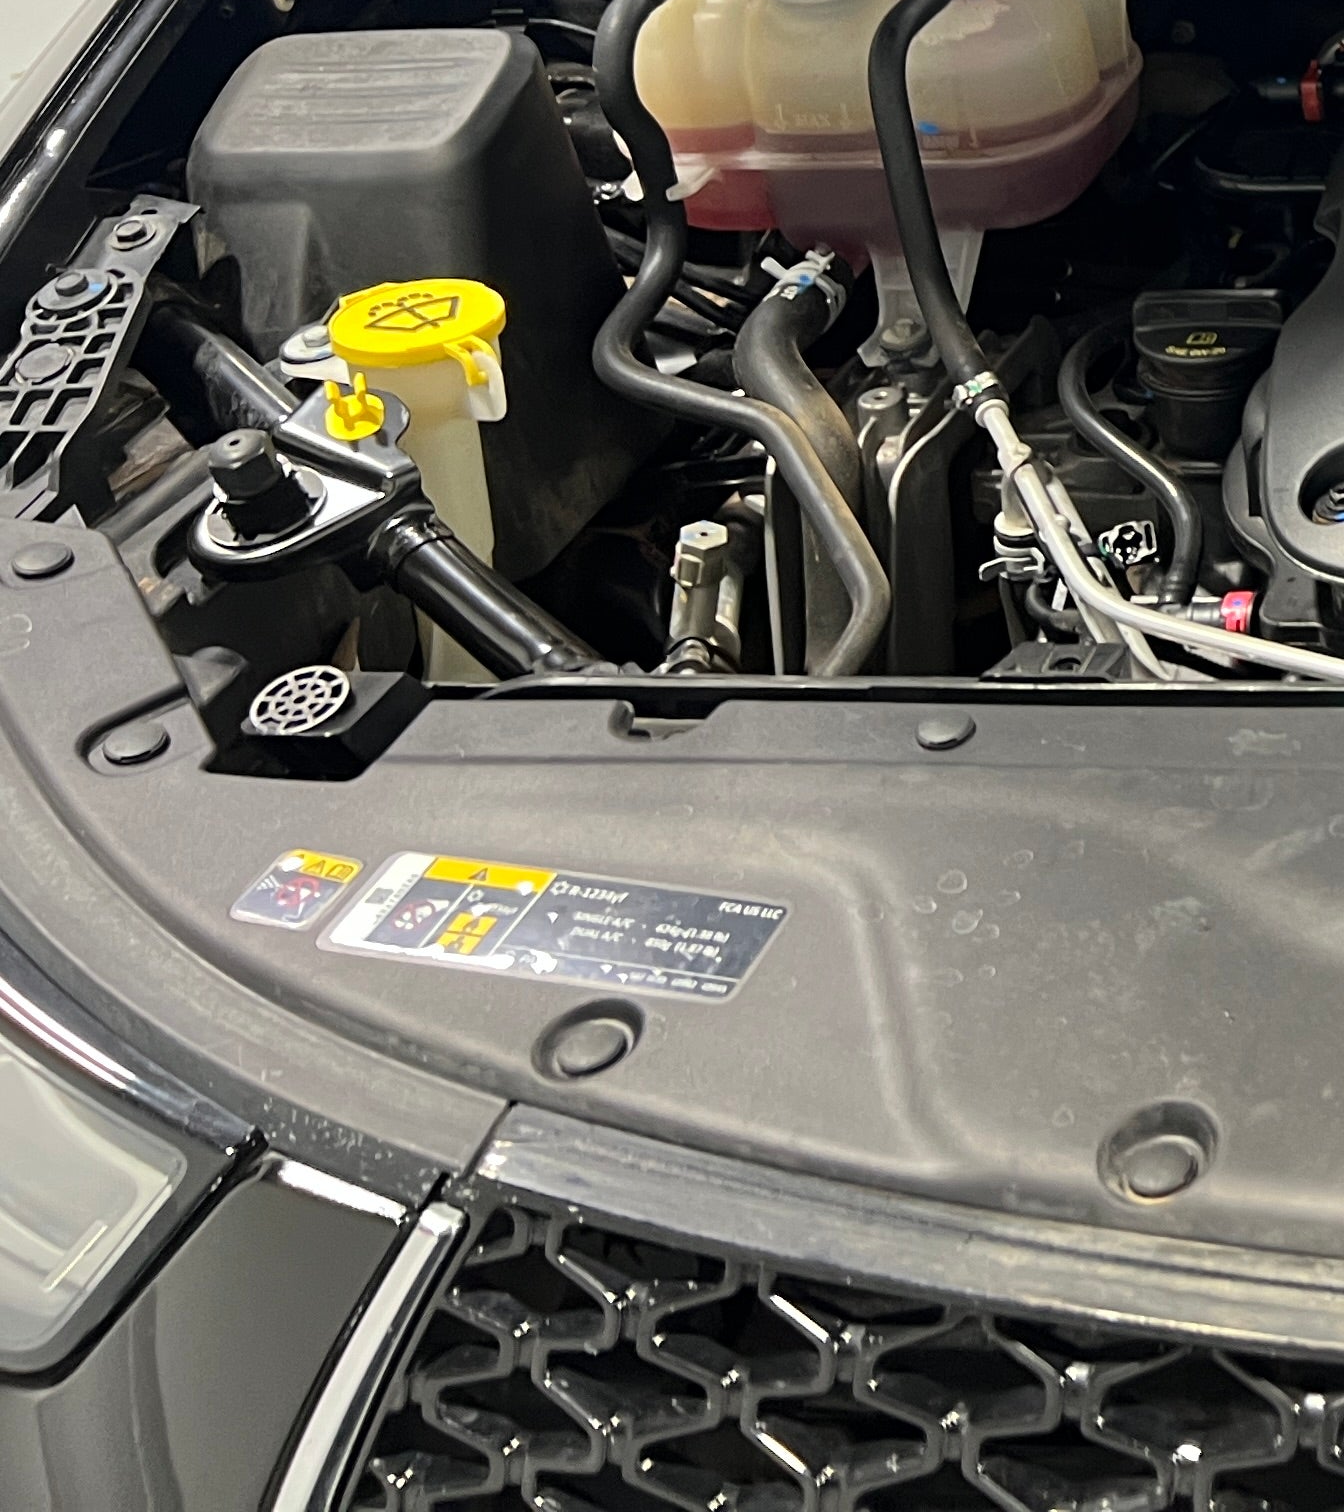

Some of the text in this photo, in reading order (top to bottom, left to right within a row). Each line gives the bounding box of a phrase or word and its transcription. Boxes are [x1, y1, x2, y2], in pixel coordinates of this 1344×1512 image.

[718, 901, 783, 920] FCA US LLC
